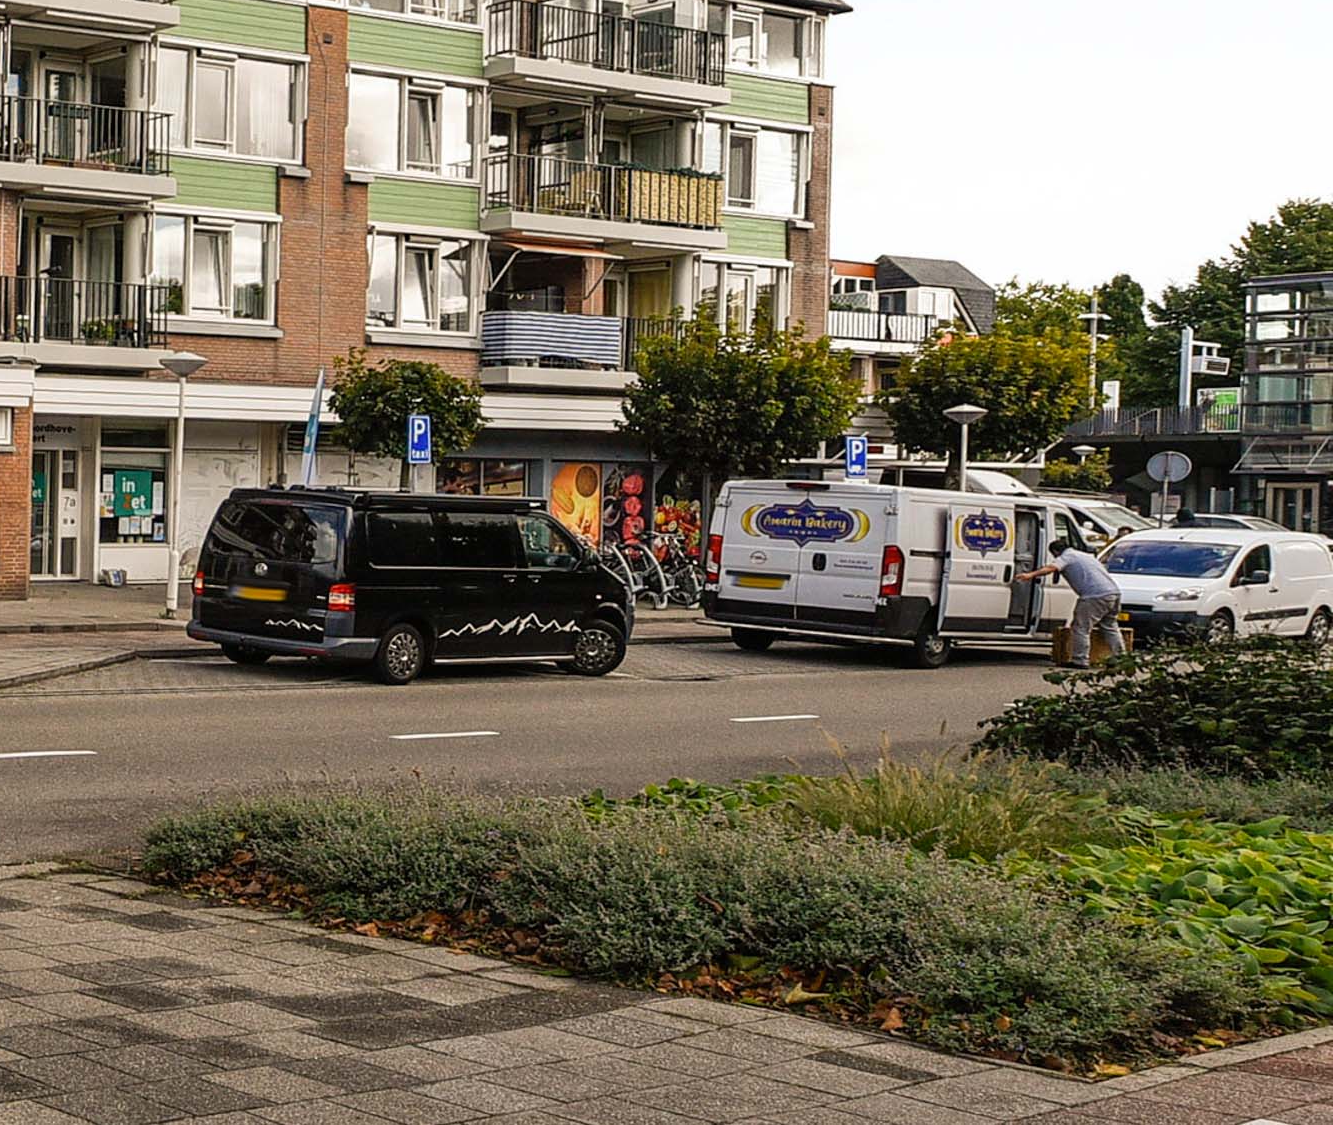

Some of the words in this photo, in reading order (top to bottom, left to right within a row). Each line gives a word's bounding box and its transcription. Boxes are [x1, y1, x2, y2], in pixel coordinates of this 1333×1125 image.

[121, 477, 135, 493] in
[32, 488, 42, 498] et
[63, 496, 76, 509] 7a
[805, 515, 847, 533] Bakery
